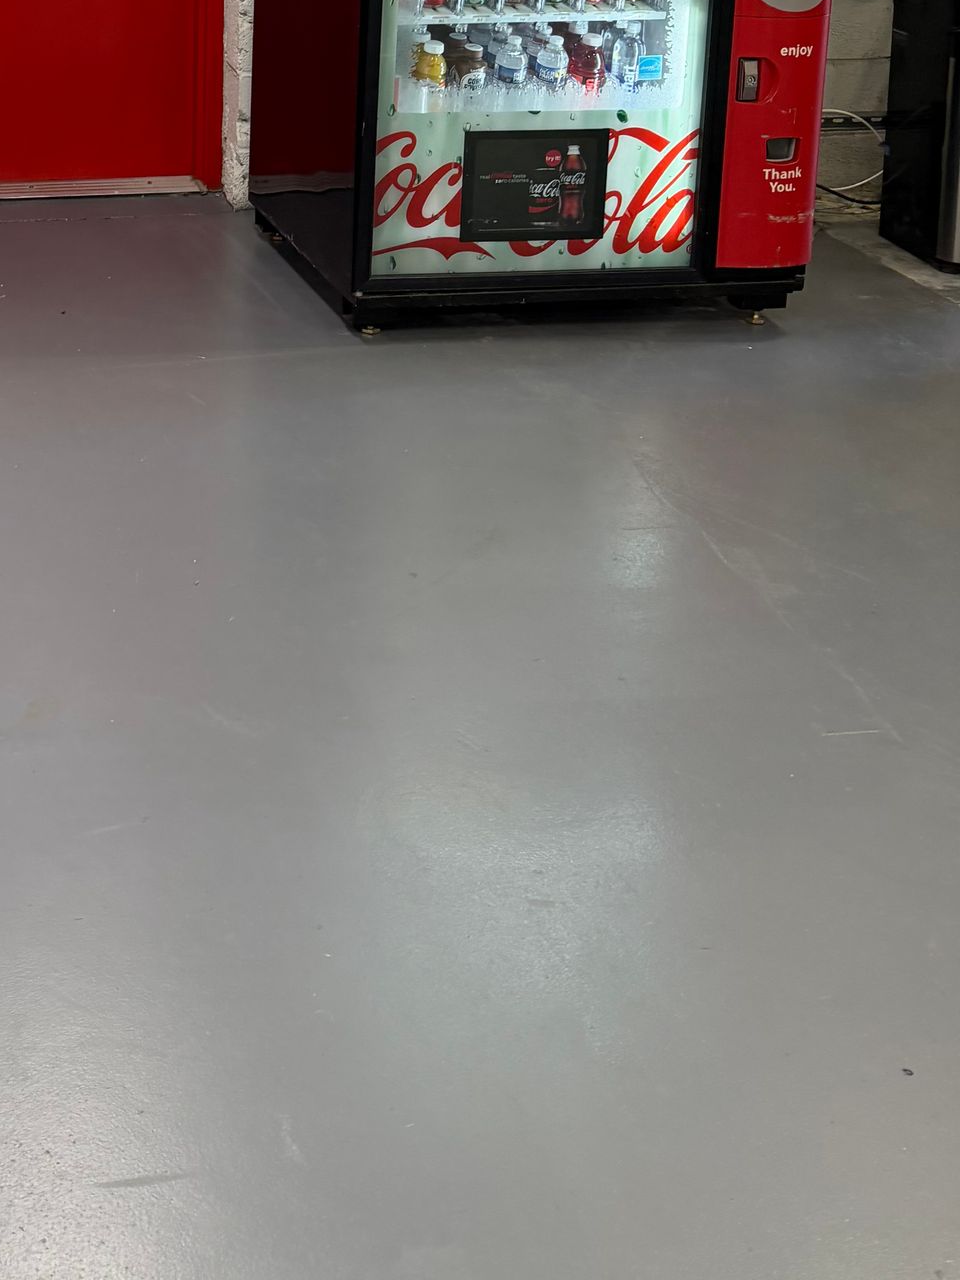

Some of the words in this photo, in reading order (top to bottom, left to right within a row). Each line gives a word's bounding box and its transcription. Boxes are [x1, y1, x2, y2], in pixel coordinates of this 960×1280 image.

[780, 44, 813, 57] enjoy
[763, 167, 802, 180] Thank
[769, 181, 796, 192] You.
